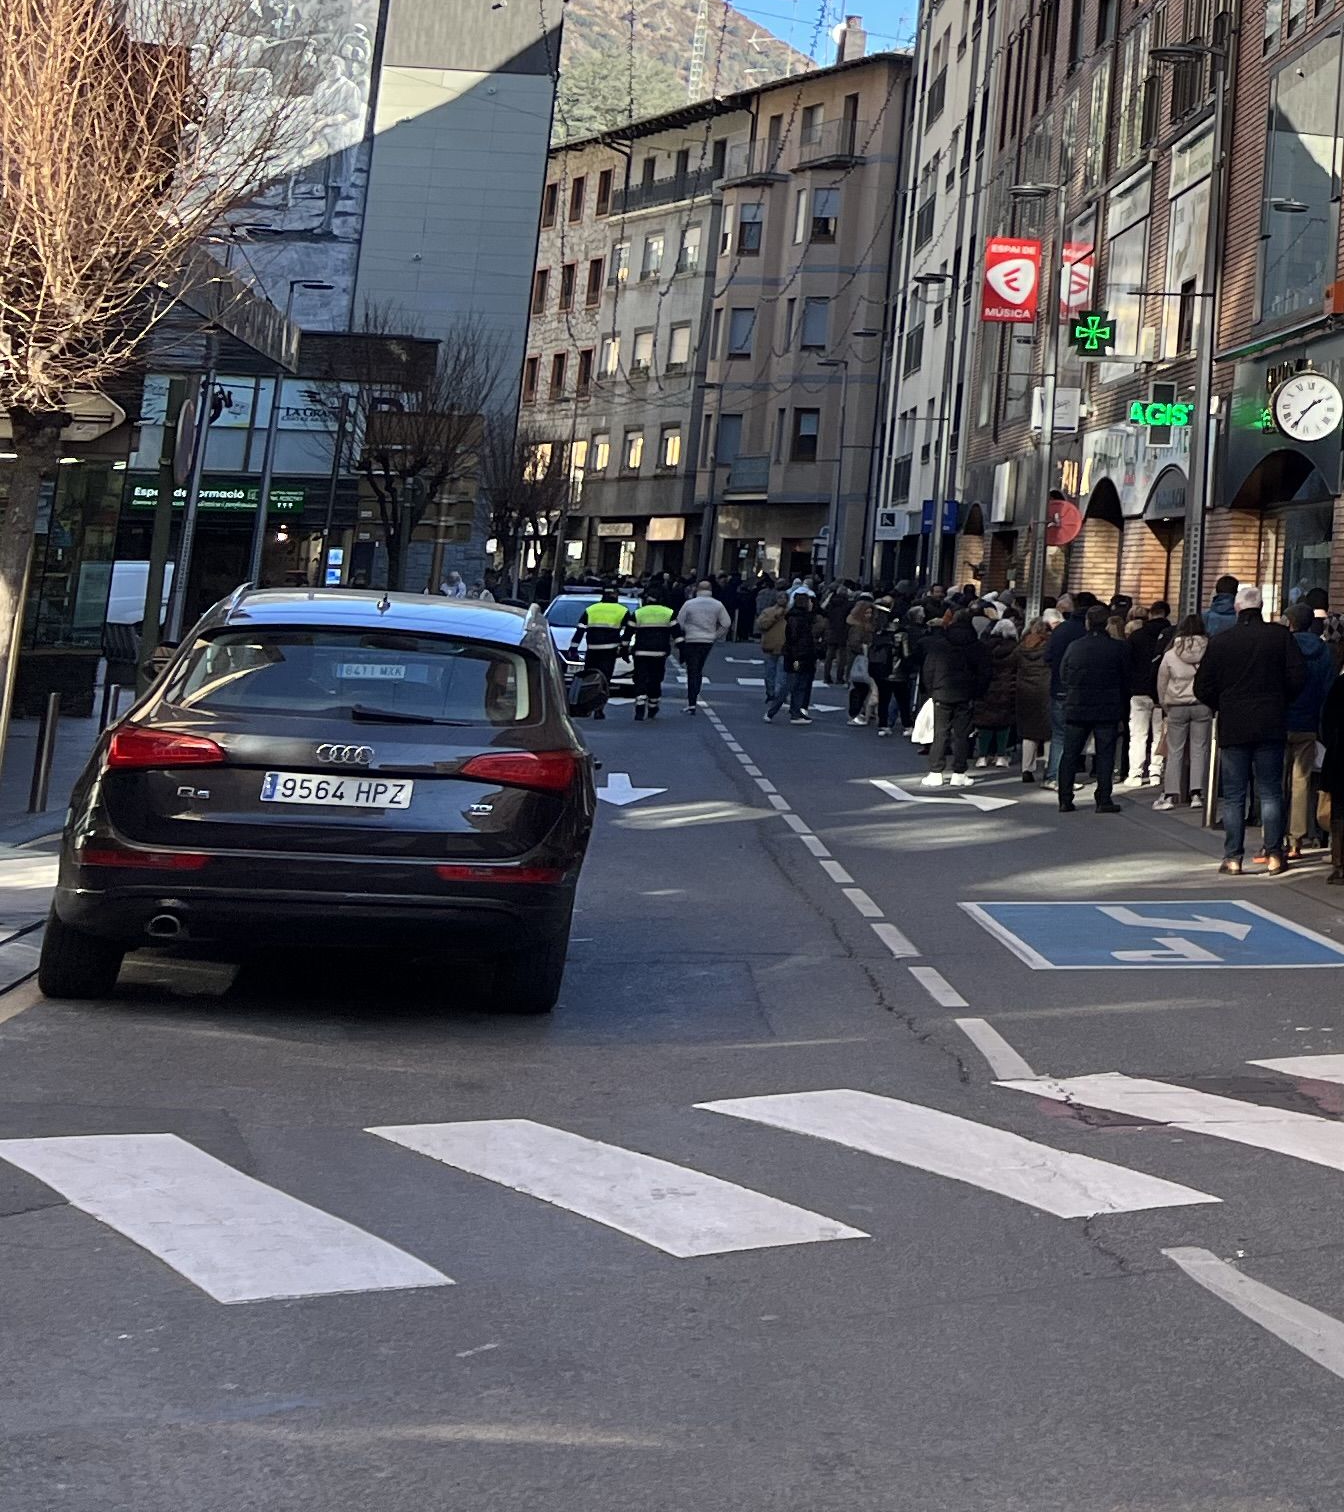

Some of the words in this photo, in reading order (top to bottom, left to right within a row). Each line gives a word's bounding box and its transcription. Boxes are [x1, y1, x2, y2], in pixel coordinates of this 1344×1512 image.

[990, 243, 1018, 254] ESPAI
[1021, 245, 1037, 255] DE
[1130, 402, 1195, 426] AGIS
[281, 778, 345, 801] 9564
[355, 781, 406, 805] HPZ
